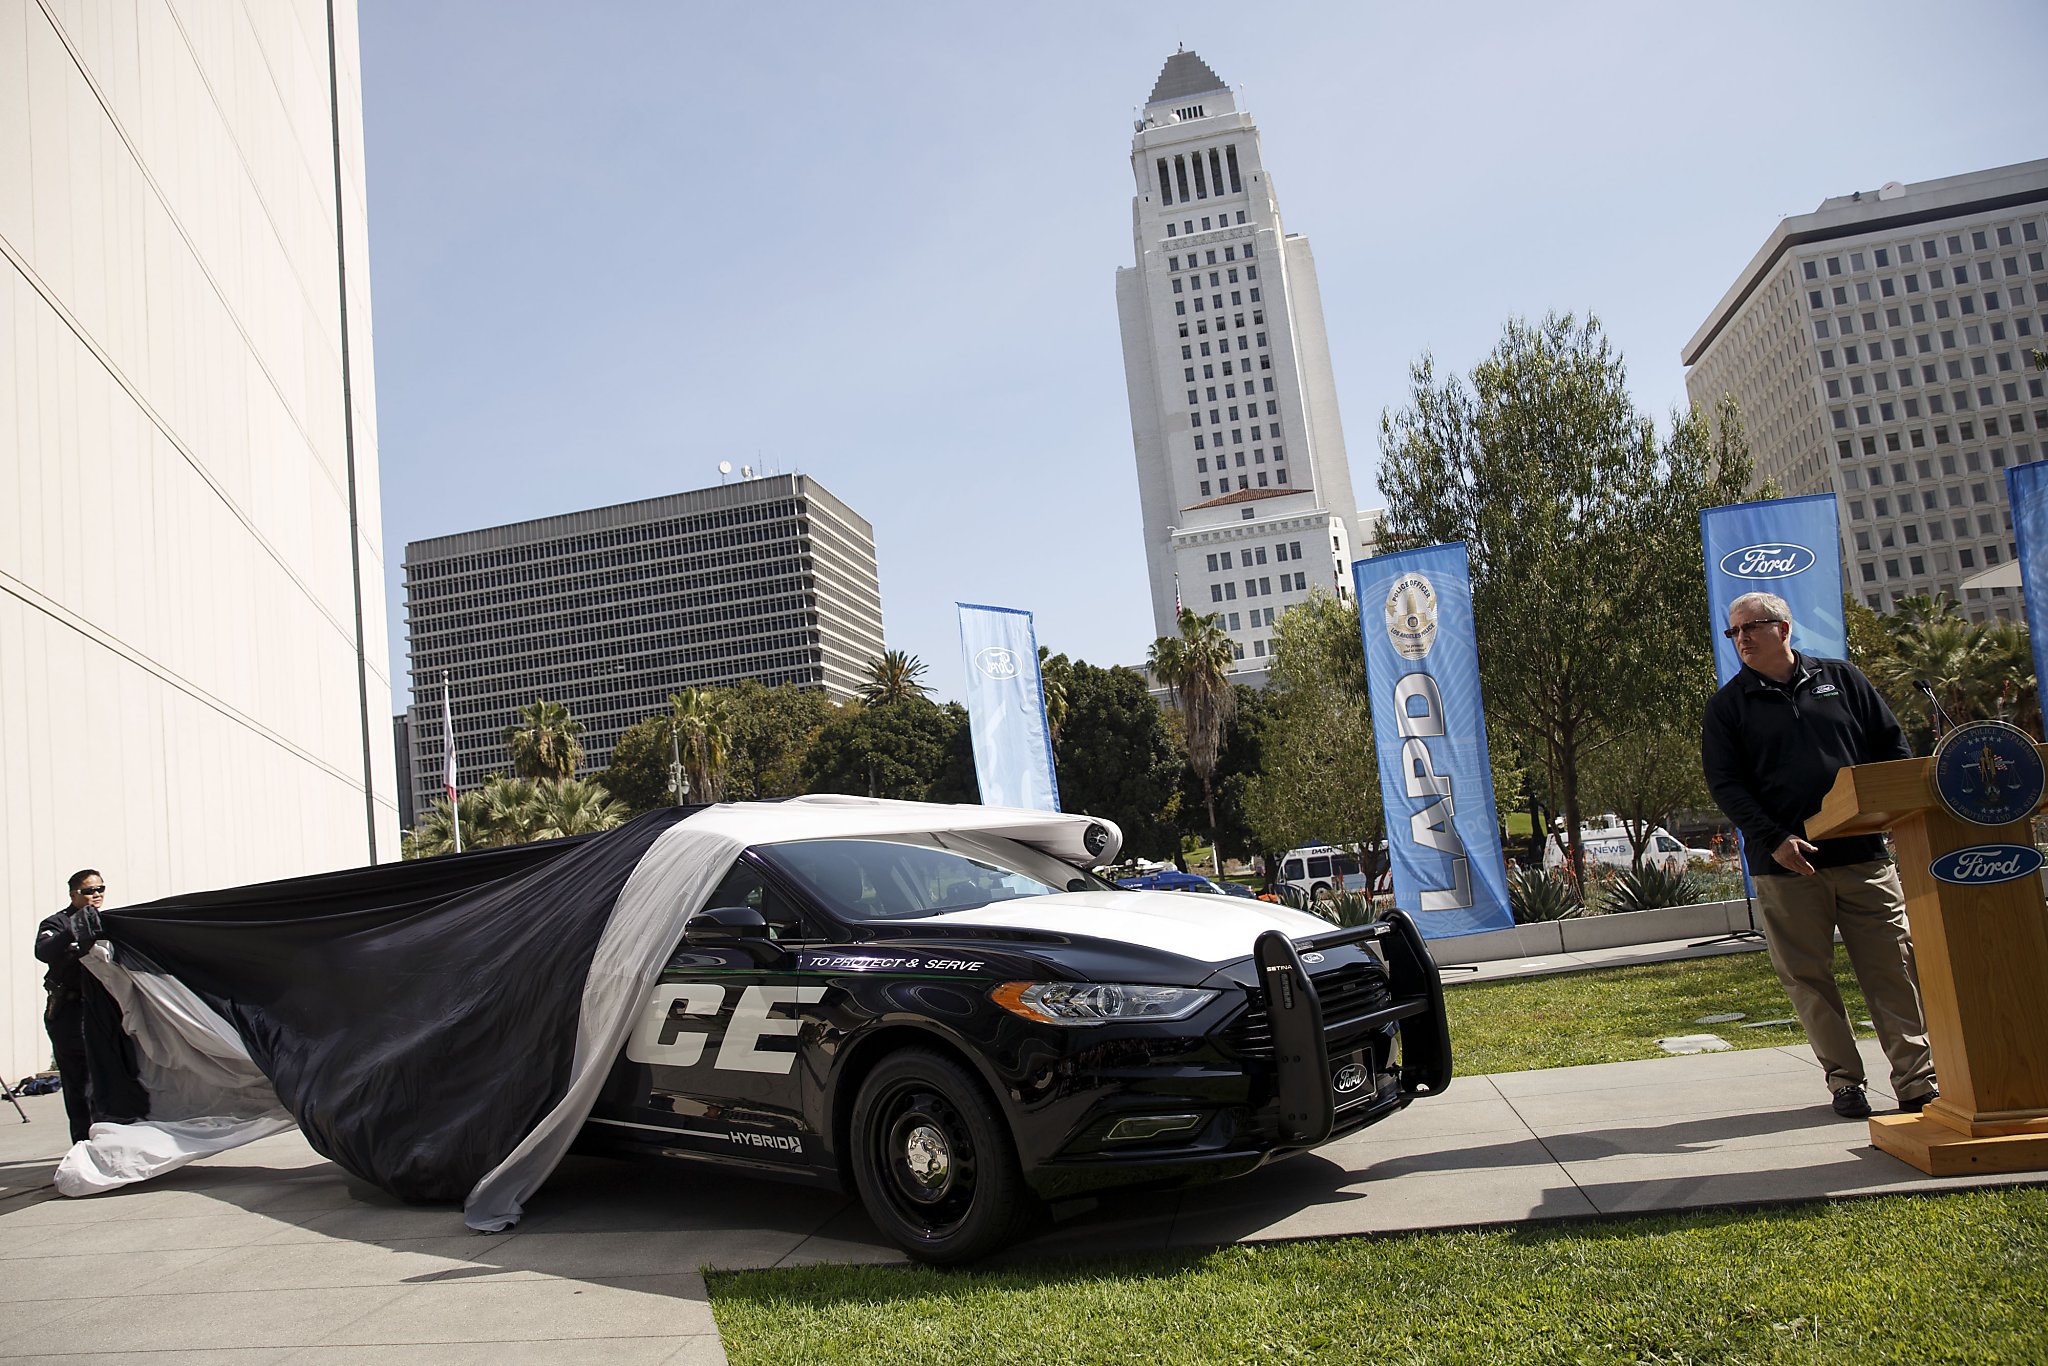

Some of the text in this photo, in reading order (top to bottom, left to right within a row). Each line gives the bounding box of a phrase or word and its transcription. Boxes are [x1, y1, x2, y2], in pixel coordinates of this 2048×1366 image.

[1738, 548, 1797, 574] Ford
[1392, 580, 1431, 602] POLICE OFFICER
[1391, 627, 1400, 636] LOS
[1970, 728, 1997, 739] POLICE
[2001, 729, 2039, 767] DEPARTMENT
[1394, 673, 1473, 912] LAPD
[1958, 804, 1991, 822] PROTECT
[1996, 813, 2011, 822] AND
[2015, 807, 2024, 816] TO
[1594, 845, 1626, 854] NEWS
[1953, 850, 2020, 879] Ford
[809, 957, 985, 972] TO PROTECT & SERVE
[1266, 964, 1293, 972] SETINA
[626, 983, 828, 1075] CE
[1339, 1066, 1362, 1090] Ford
[729, 1131, 791, 1150] HYBRID
